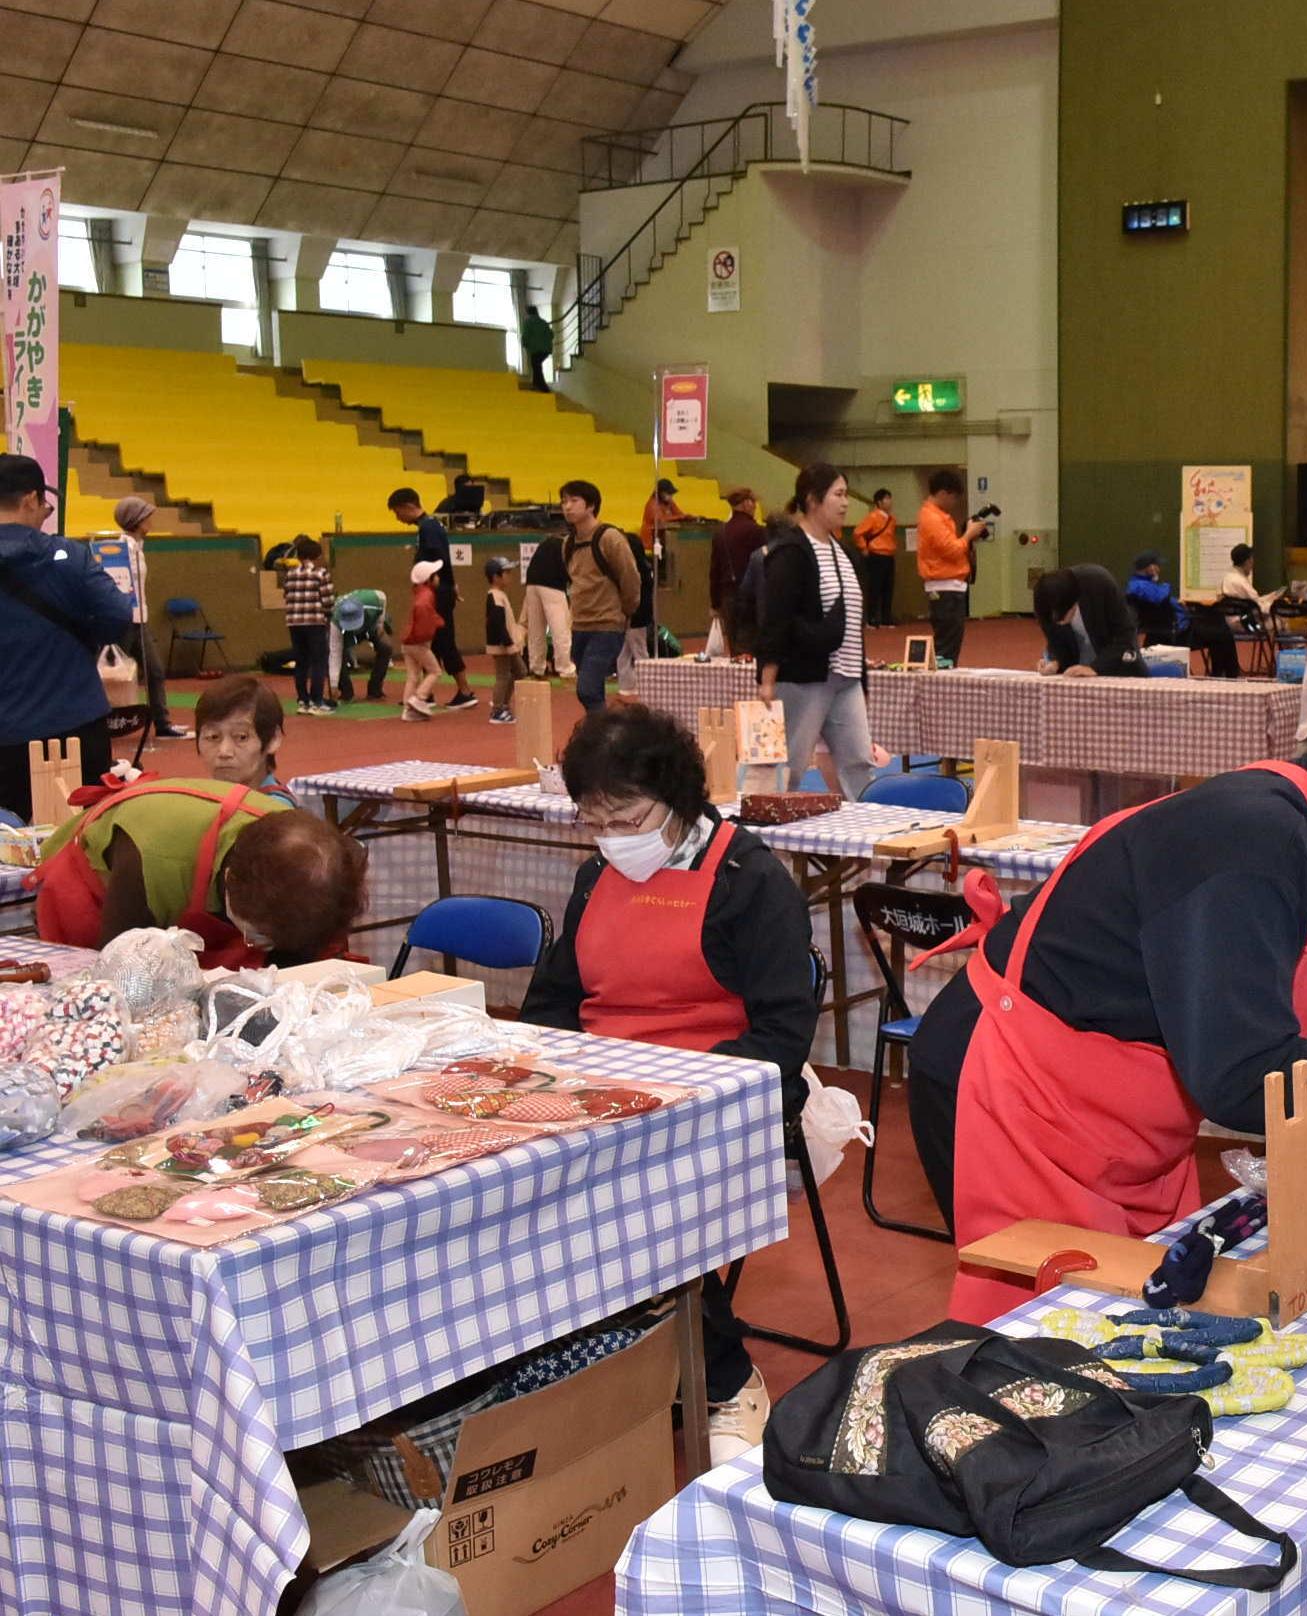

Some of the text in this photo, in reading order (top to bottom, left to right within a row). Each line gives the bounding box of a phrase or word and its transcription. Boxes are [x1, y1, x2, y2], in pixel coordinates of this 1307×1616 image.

[27, 270, 47, 408] かがやき
[880, 905, 965, 936] 大垣城ホール
[468, 1455, 526, 1485] コワレモノ
[532, 1535, 560, 1554] Cozy
[560, 1515, 593, 1538] Corner
